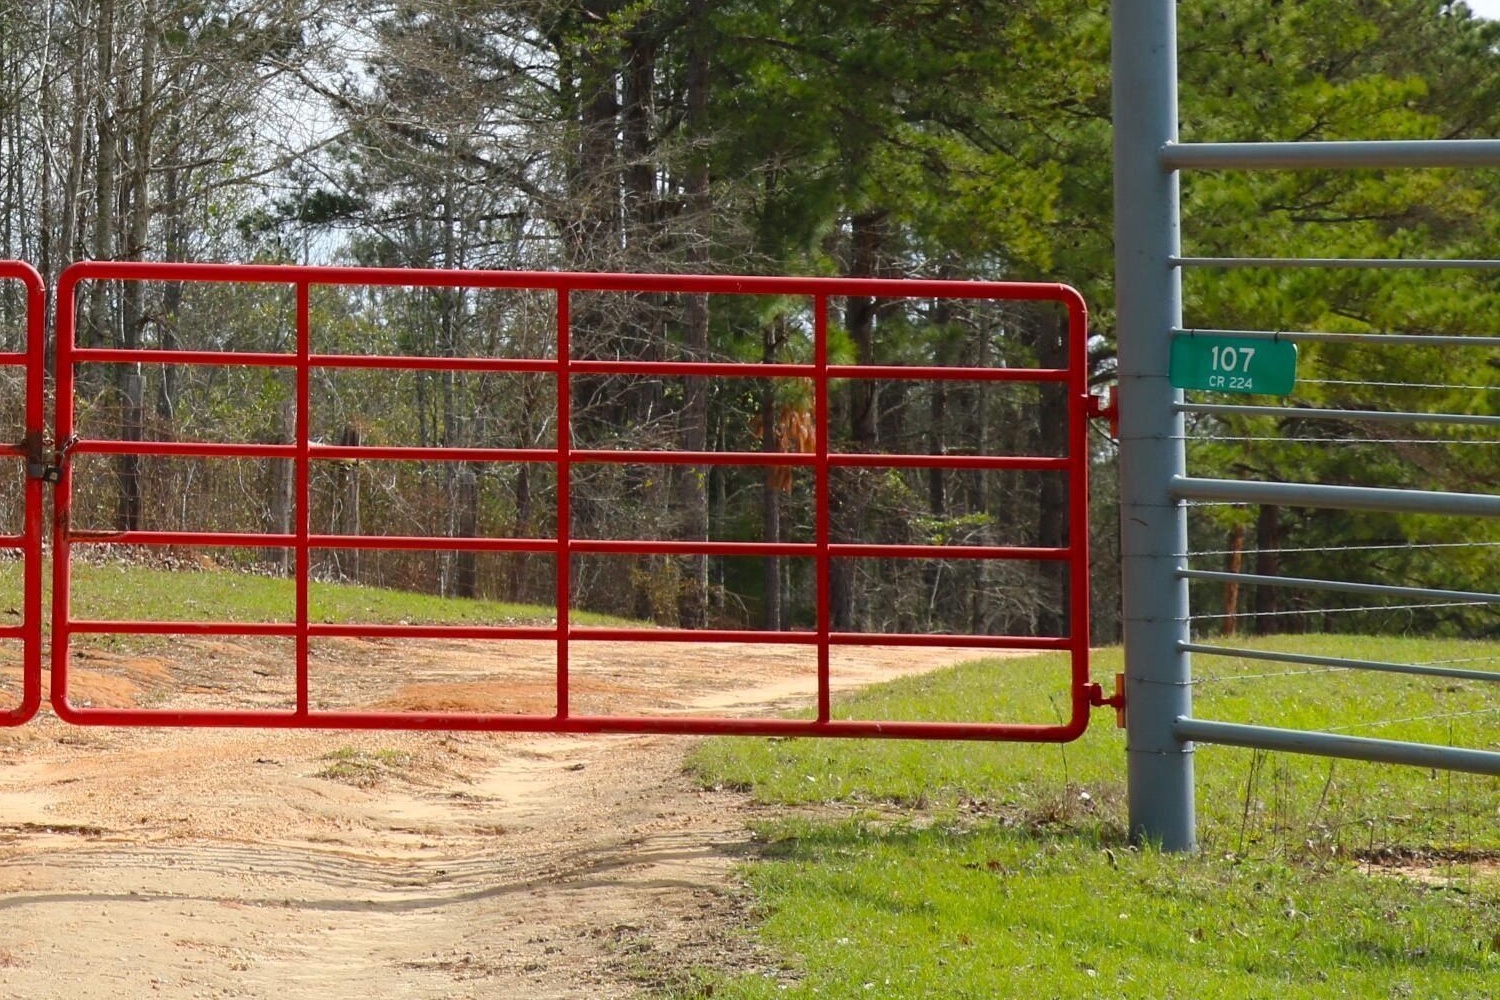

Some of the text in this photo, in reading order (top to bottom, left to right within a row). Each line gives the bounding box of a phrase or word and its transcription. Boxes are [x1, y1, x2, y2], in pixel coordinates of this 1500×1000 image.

[1211, 345, 1256, 373] 107
[1208, 375, 1253, 389] CR 224
